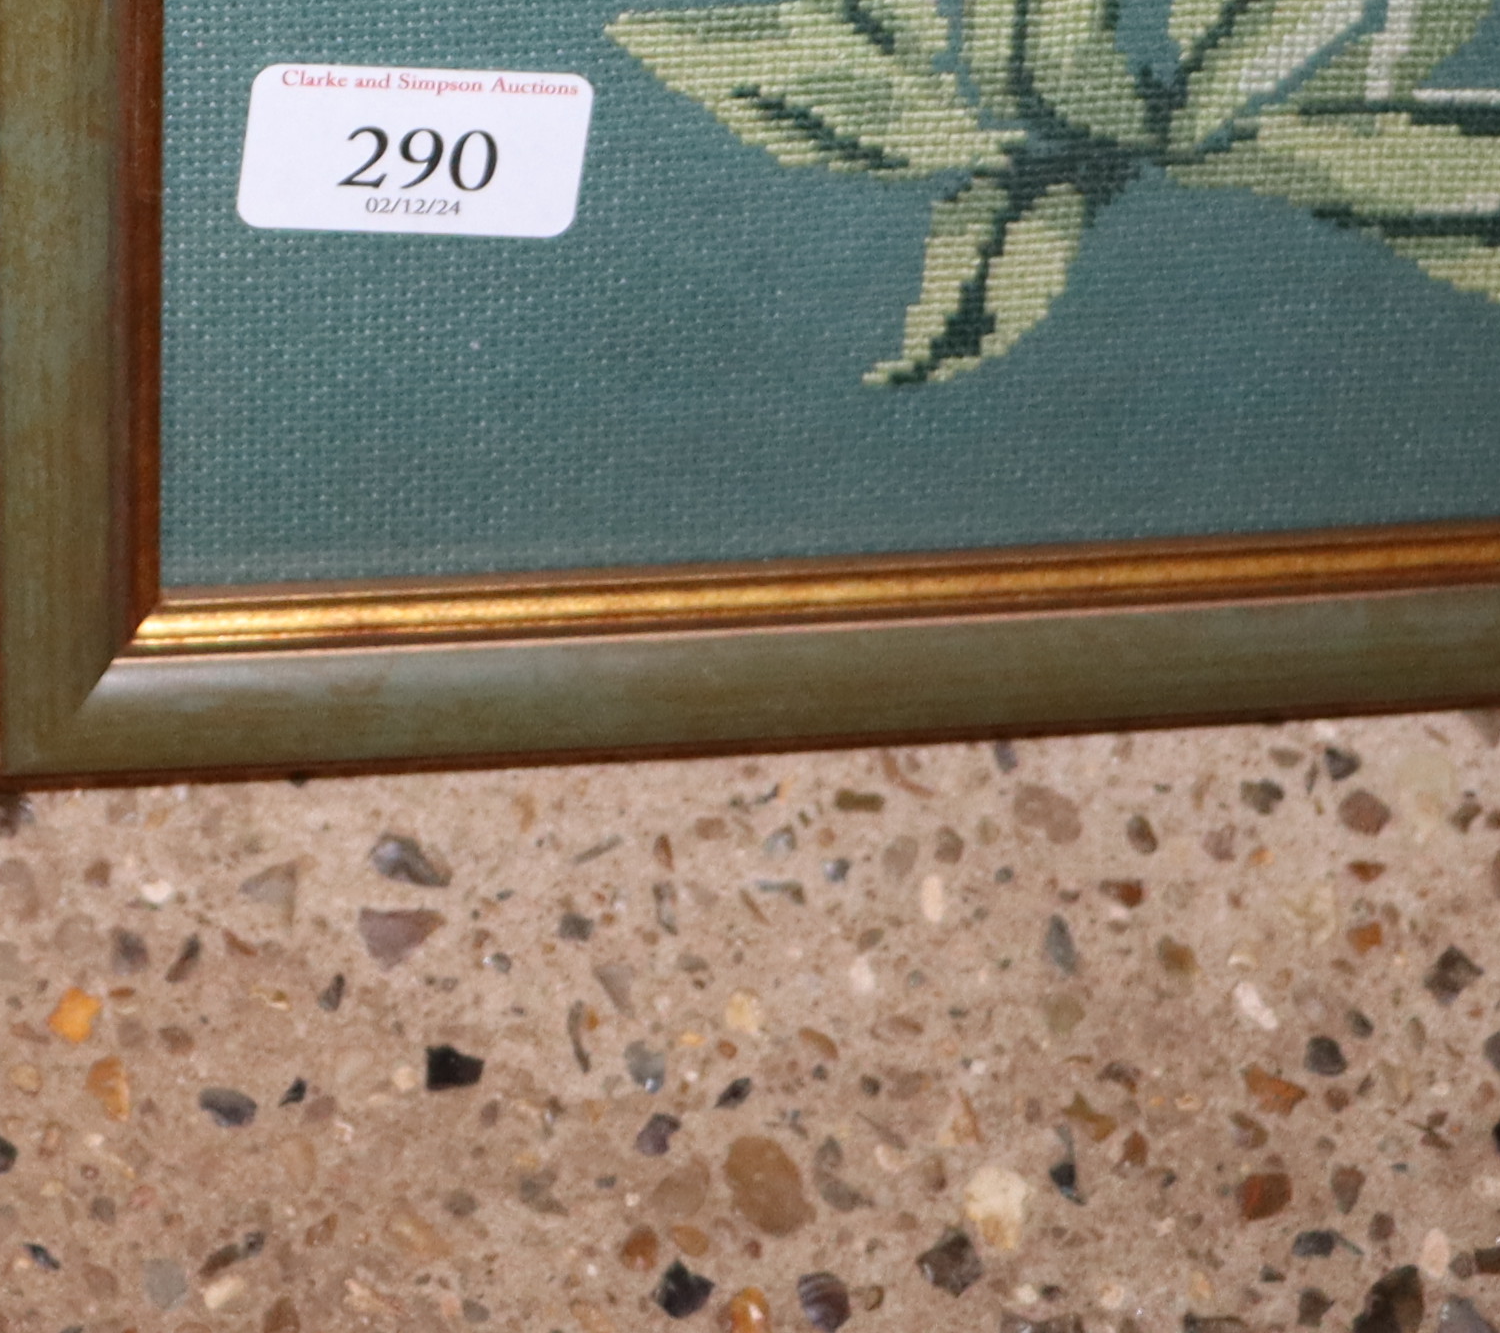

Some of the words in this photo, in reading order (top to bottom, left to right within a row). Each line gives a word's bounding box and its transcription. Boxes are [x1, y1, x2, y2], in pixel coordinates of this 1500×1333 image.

[281, 69, 348, 88] Clarke
[354, 72, 391, 90] and
[398, 73, 483, 96] Simpson
[491, 76, 579, 96] Auctions
[337, 126, 498, 191] 290
[364, 197, 462, 216] 02/12/24
